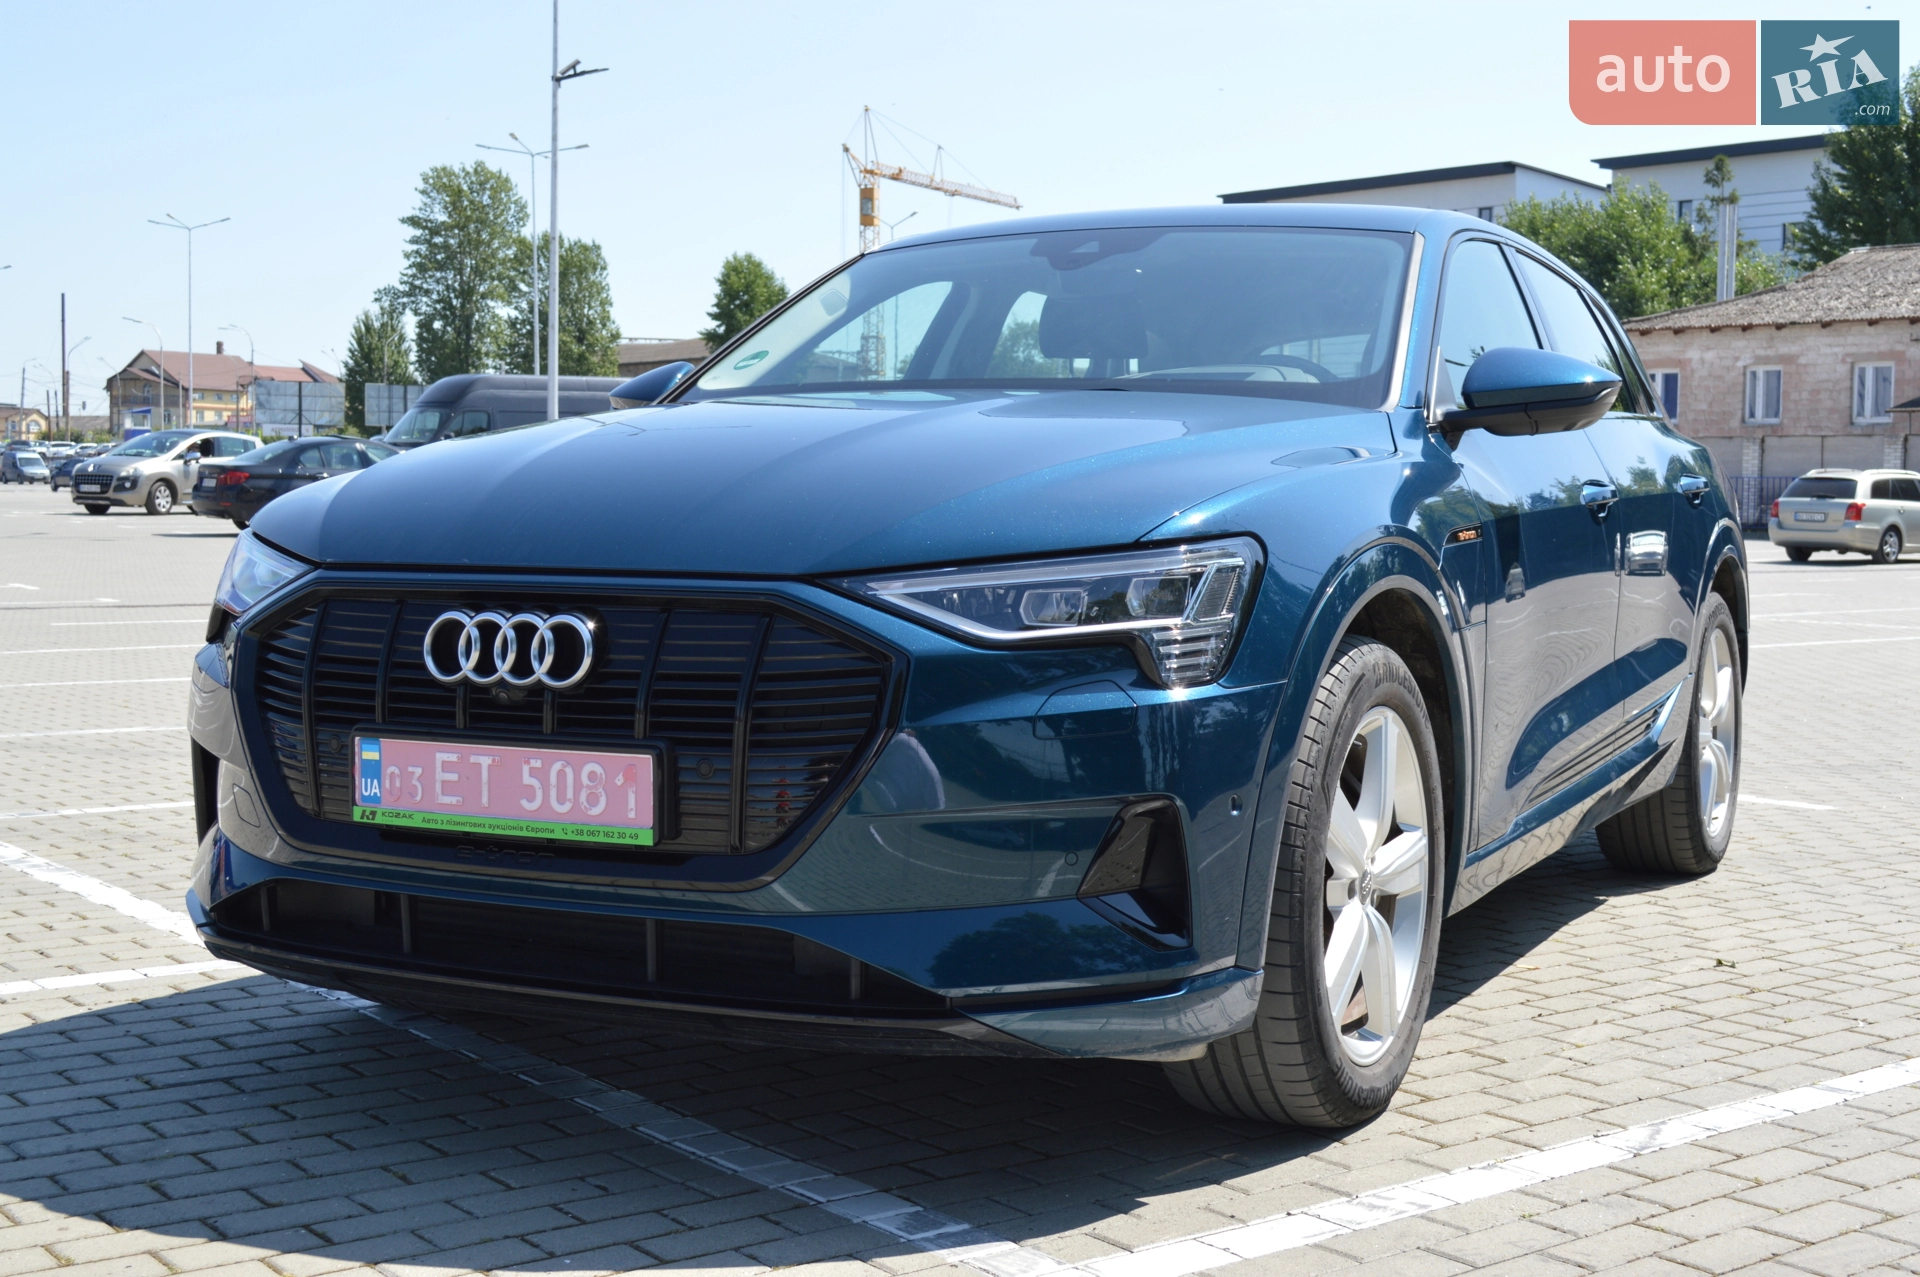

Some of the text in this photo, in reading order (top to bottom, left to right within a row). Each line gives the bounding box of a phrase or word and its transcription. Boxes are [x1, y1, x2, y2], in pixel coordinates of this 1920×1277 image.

[361, 778, 381, 797] UA
[385, 751, 638, 819] 03 ET 5081
[381, 811, 415, 820] KOZAK
[421, 816, 439, 825] Авто
[445, 818, 487, 829] лізингових
[487, 822, 524, 832] аукціонів
[525, 824, 555, 835] Європи
[570, 828, 639, 841] +38 067 162 30 49
